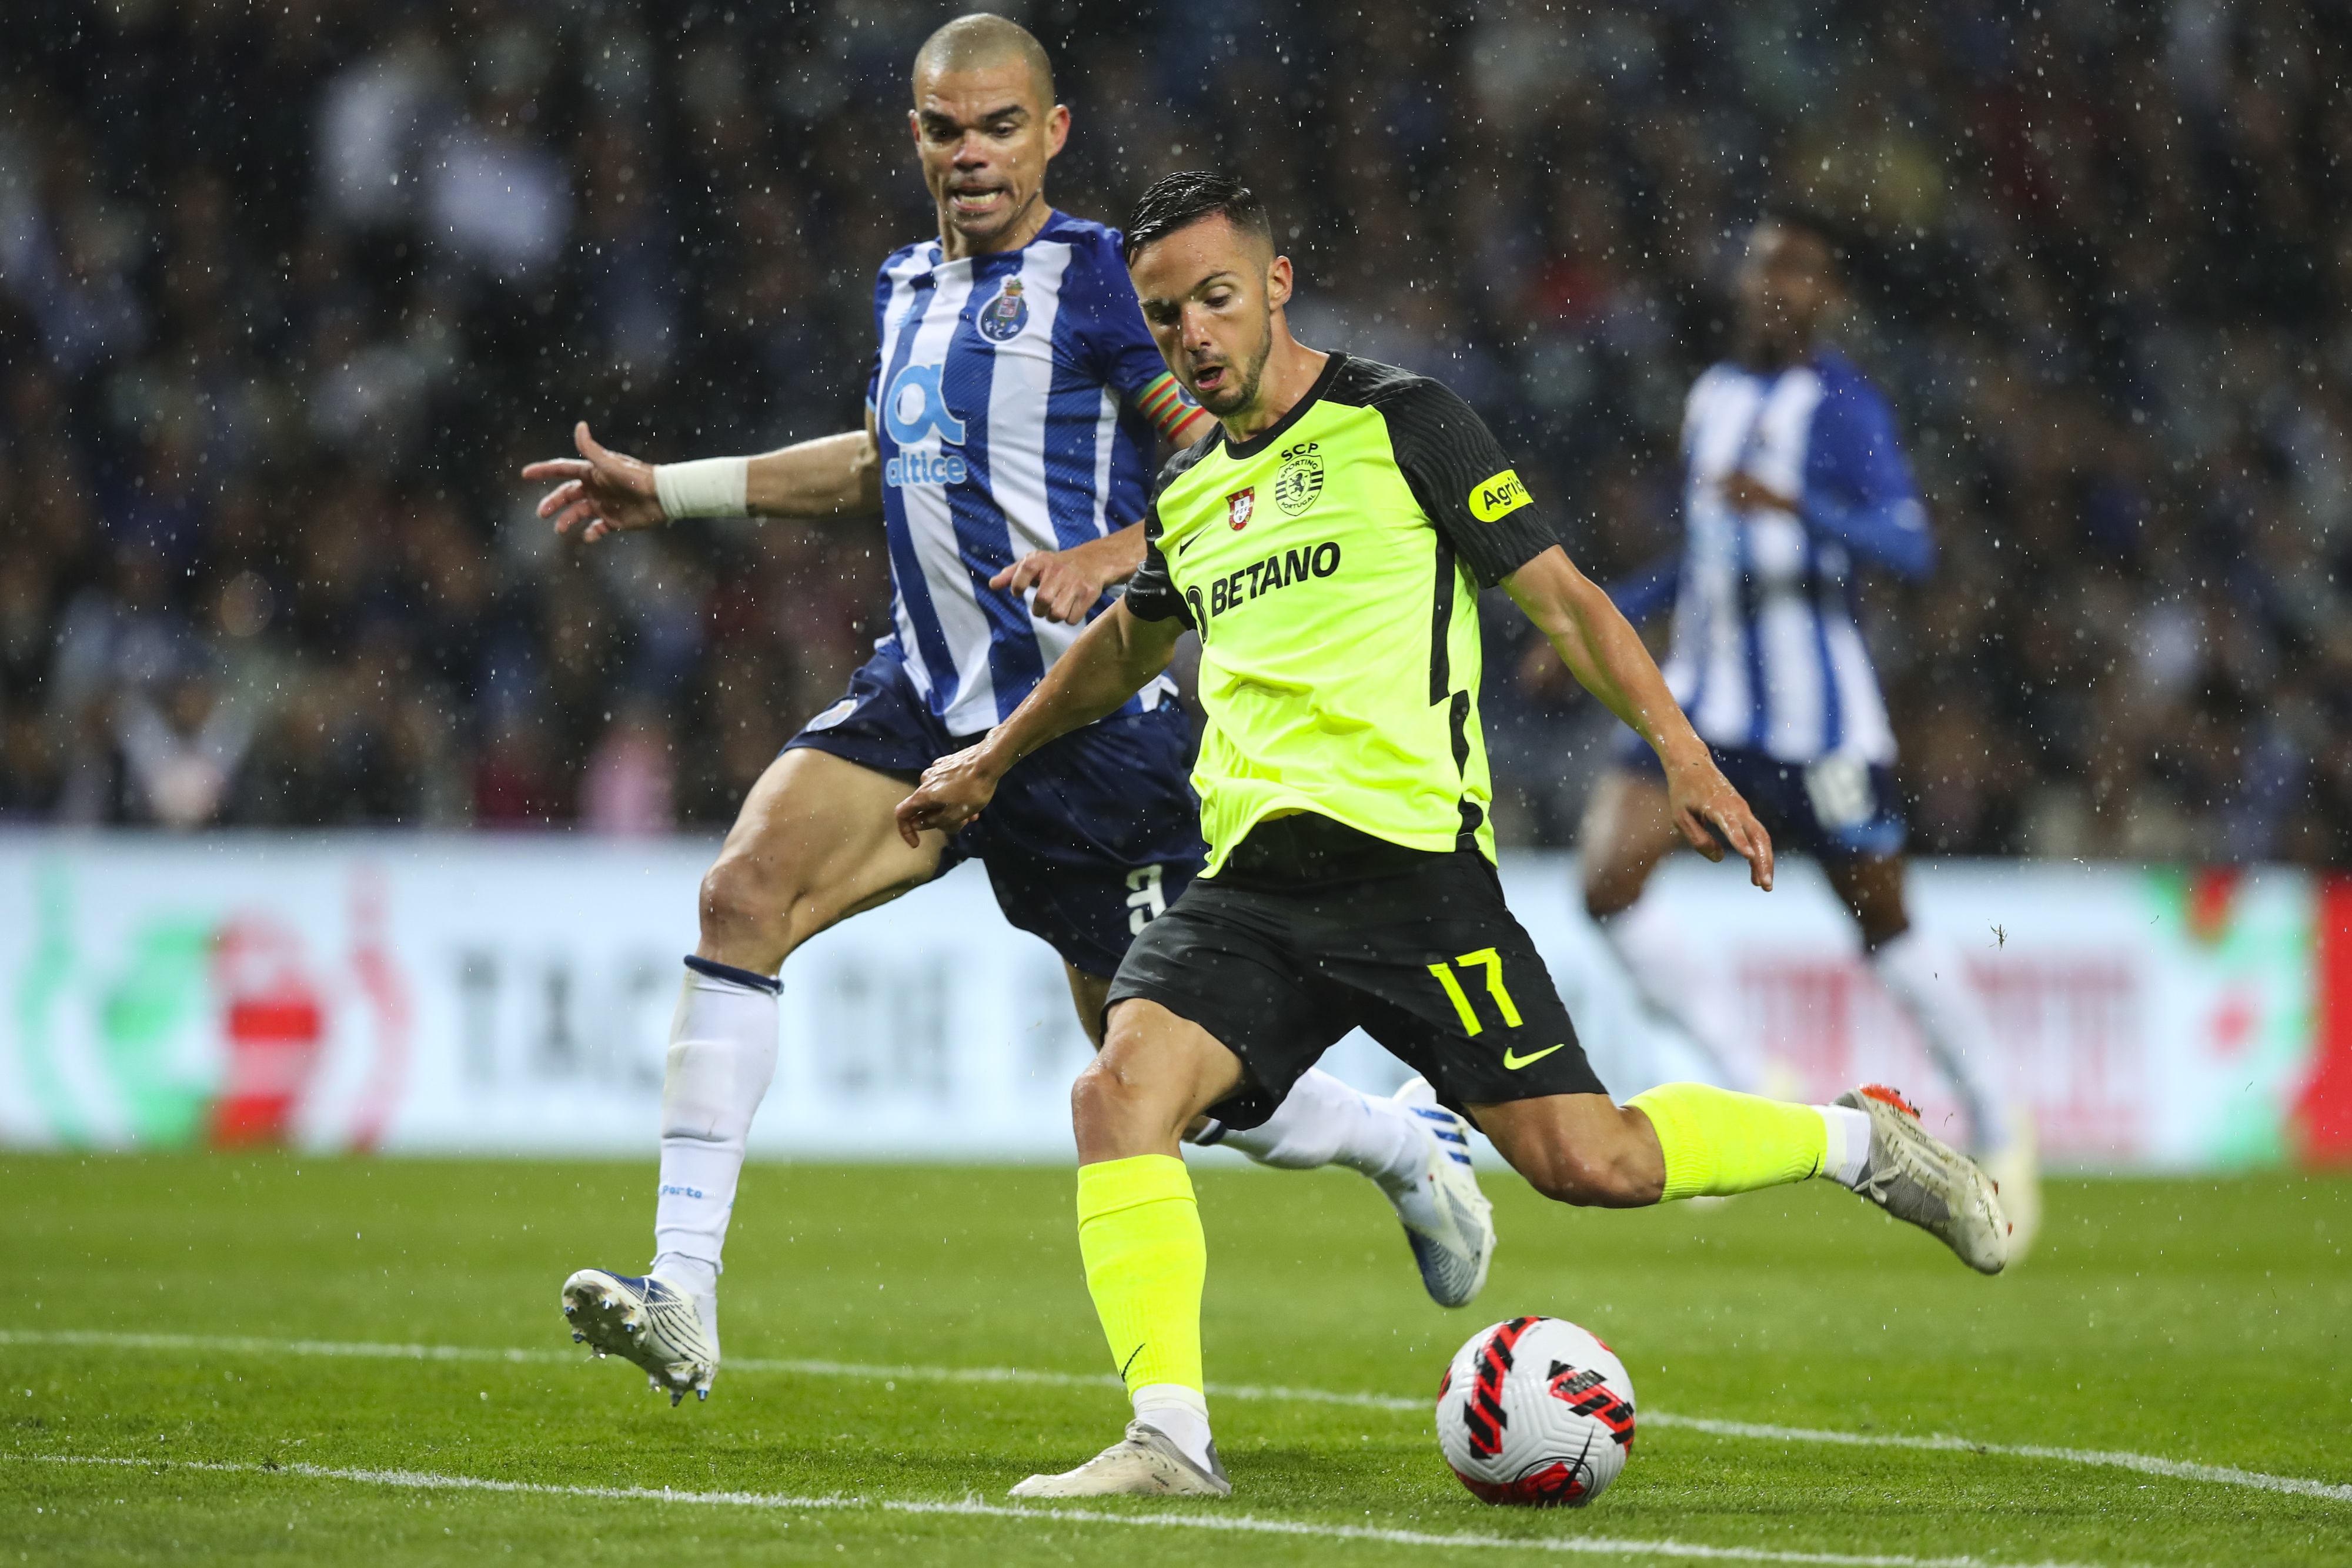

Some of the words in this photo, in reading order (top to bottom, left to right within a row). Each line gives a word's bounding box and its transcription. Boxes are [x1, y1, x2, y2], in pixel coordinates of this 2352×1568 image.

[1281, 442, 1319, 462] SCP
[886, 450, 967, 487] altice
[1280, 459, 1318, 479] SPORTING
[1281, 494, 1316, 509] PORTUGAL
[1212, 541, 1341, 618] BETANO
[1426, 947, 1524, 1037] 17
